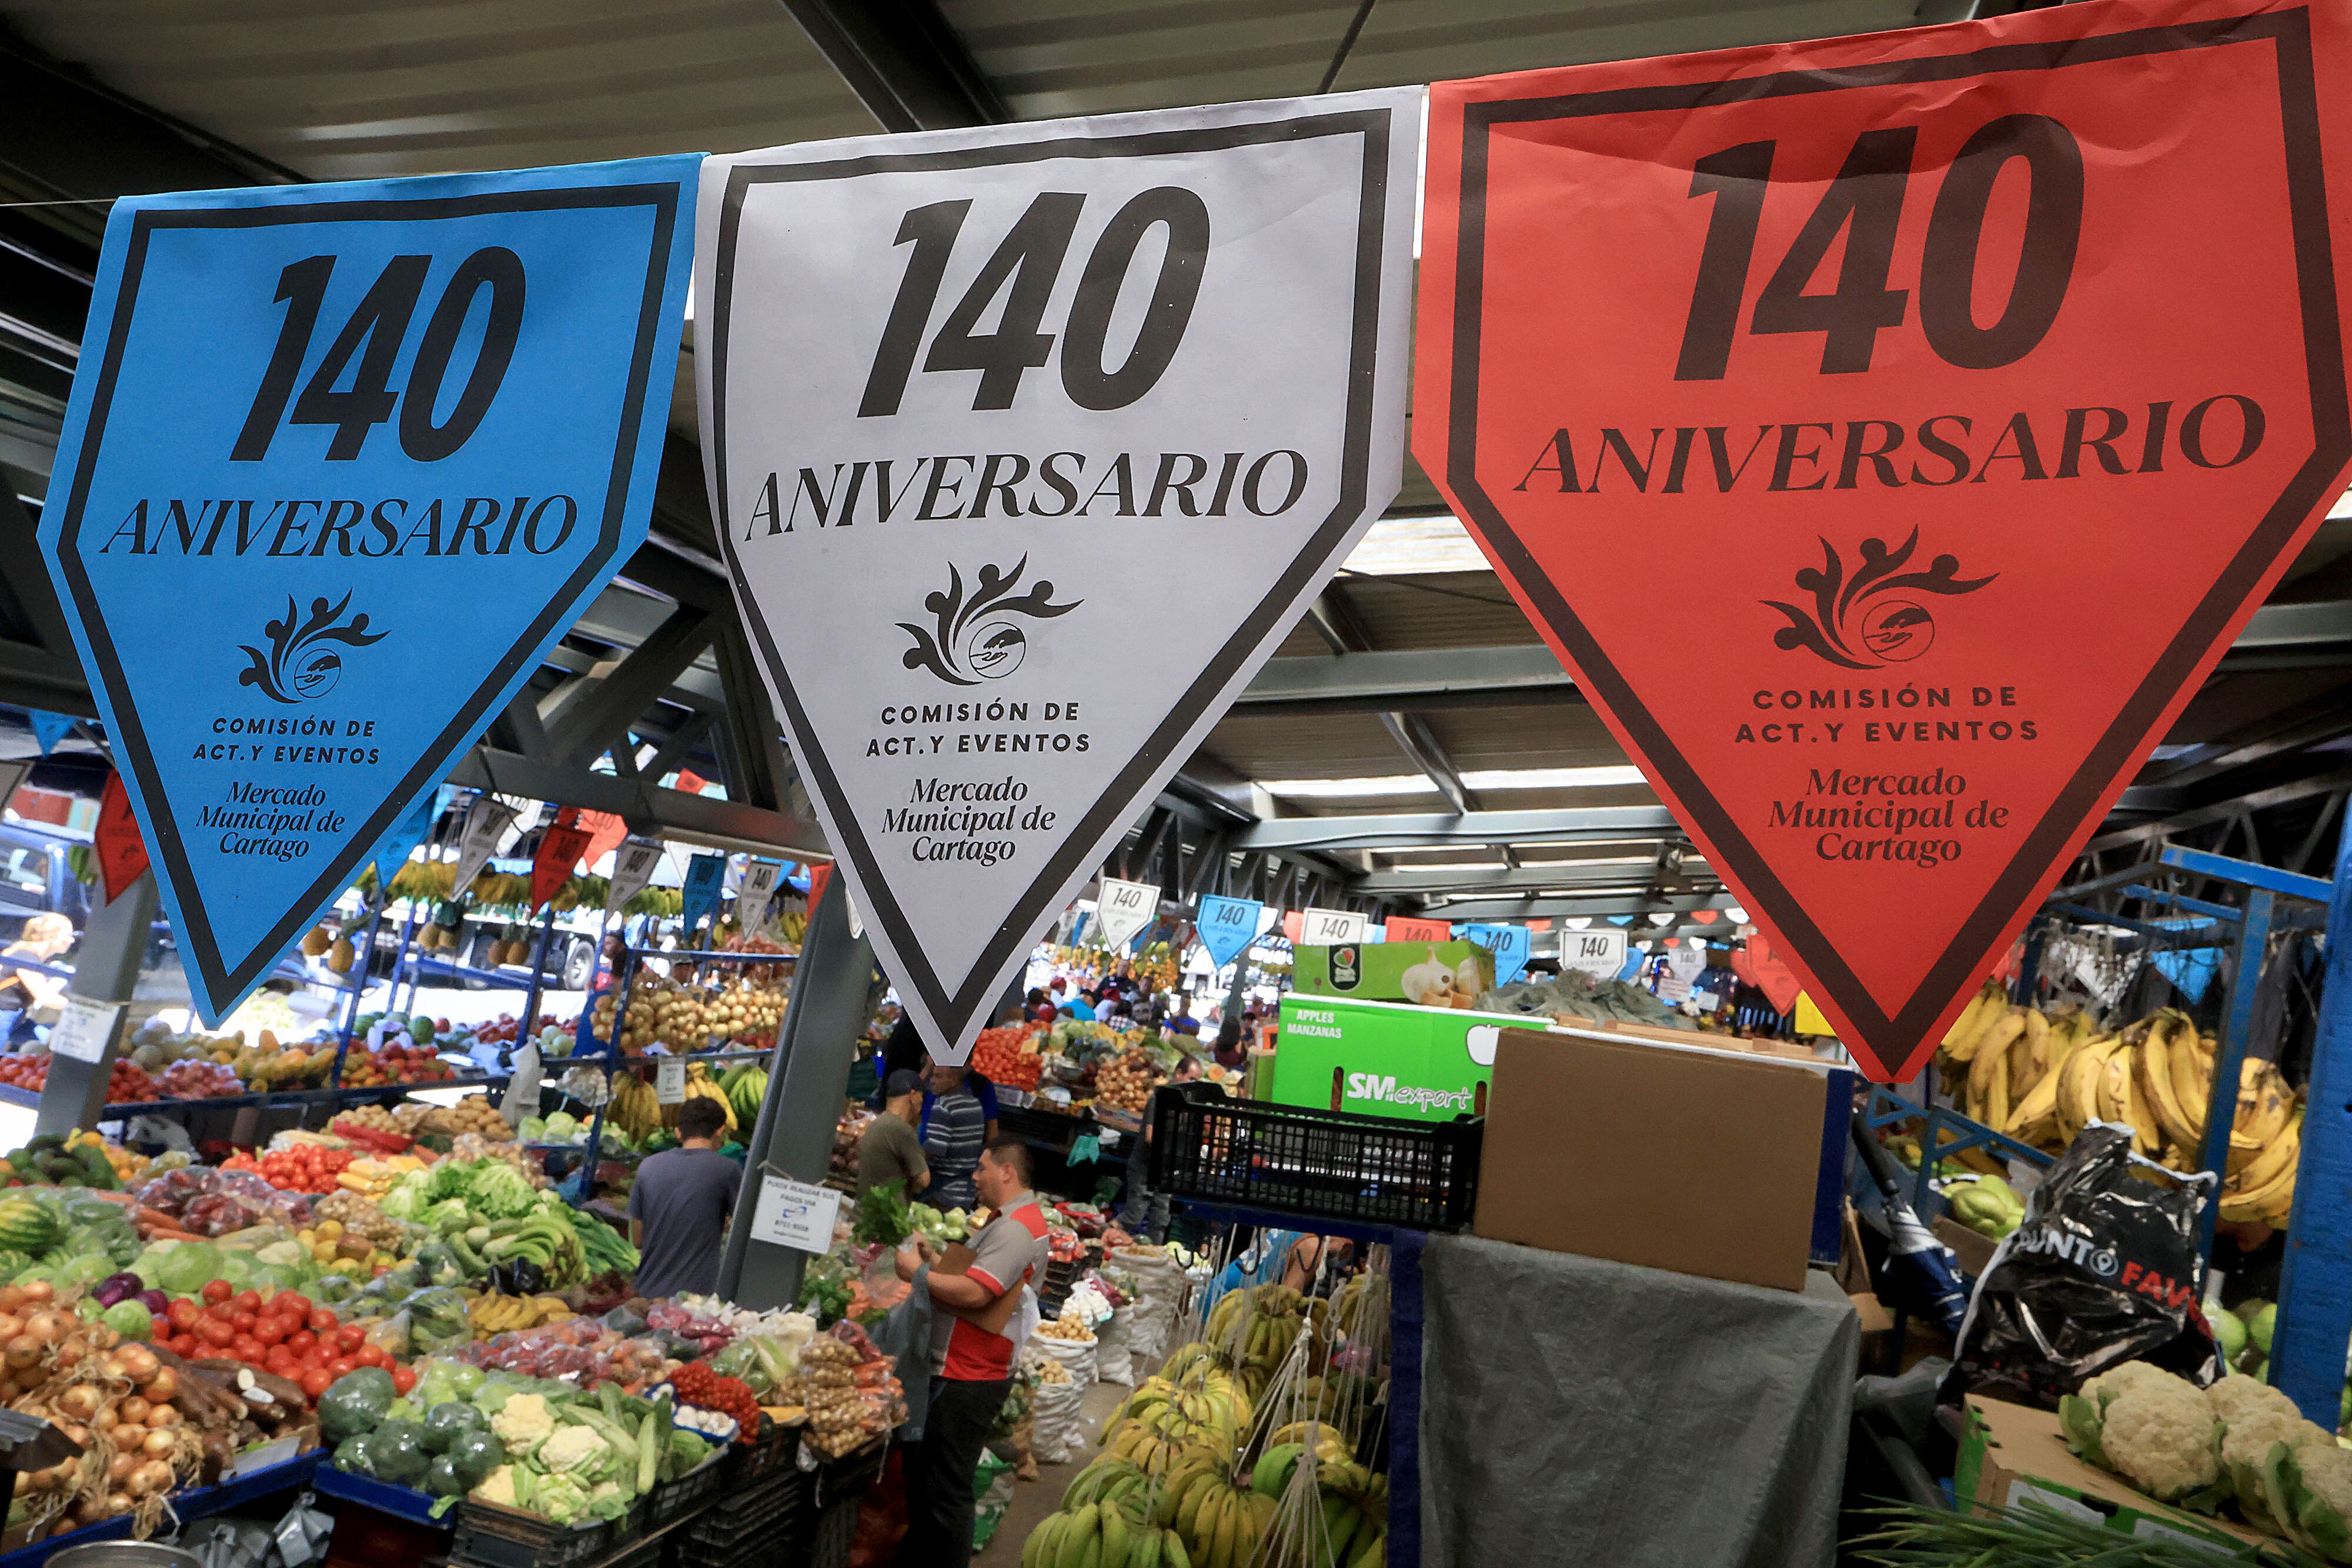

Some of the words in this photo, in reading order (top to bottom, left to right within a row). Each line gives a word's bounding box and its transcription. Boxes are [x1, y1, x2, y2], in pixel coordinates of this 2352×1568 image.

[1674, 113, 2084, 382] 140
[857, 186, 1210, 418] 140
[229, 246, 526, 462] 140
[1513, 394, 2266, 493] ANIVERSARIO
[744, 450, 1307, 541] ANIVERSARIO
[99, 495, 577, 557] ANIVERSARIO
[1753, 683, 1950, 710] COMISIÓN
[1972, 687, 2016, 706] DE
[881, 697, 1028, 724] COMISIÓN
[1045, 703, 1078, 720] DE
[213, 715, 335, 735] COMISIÓN
[346, 721, 375, 737] DE
[1866, 721, 2037, 741] EVENTOS
[274, 746, 379, 764] EVENTOS
[958, 734, 1089, 752] EVENTOS
[226, 782, 325, 805] Mercado
[910, 776, 1027, 803] Mercado
[1806, 768, 1966, 795] Mercado
[196, 806, 315, 835] Municipal
[317, 810, 345, 833] de
[881, 805, 1016, 837] Municipal
[1021, 805, 1055, 830] de
[1769, 800, 1953, 835] Municipal
[1965, 800, 2009, 828] de
[220, 832, 309, 862] Cartago
[913, 837, 1015, 866] Cartago
[1816, 833, 1961, 868] Cartago
[1113, 888, 1141, 908] 140
[1215, 904, 1245, 925] 140
[1320, 918, 1349, 938] 140
[1485, 931, 1513, 951] 140
[1580, 937, 1608, 957] 140
[1296, 1009, 1334, 1024] APPLES
[1287, 1024, 1342, 1039] MANZANAS
